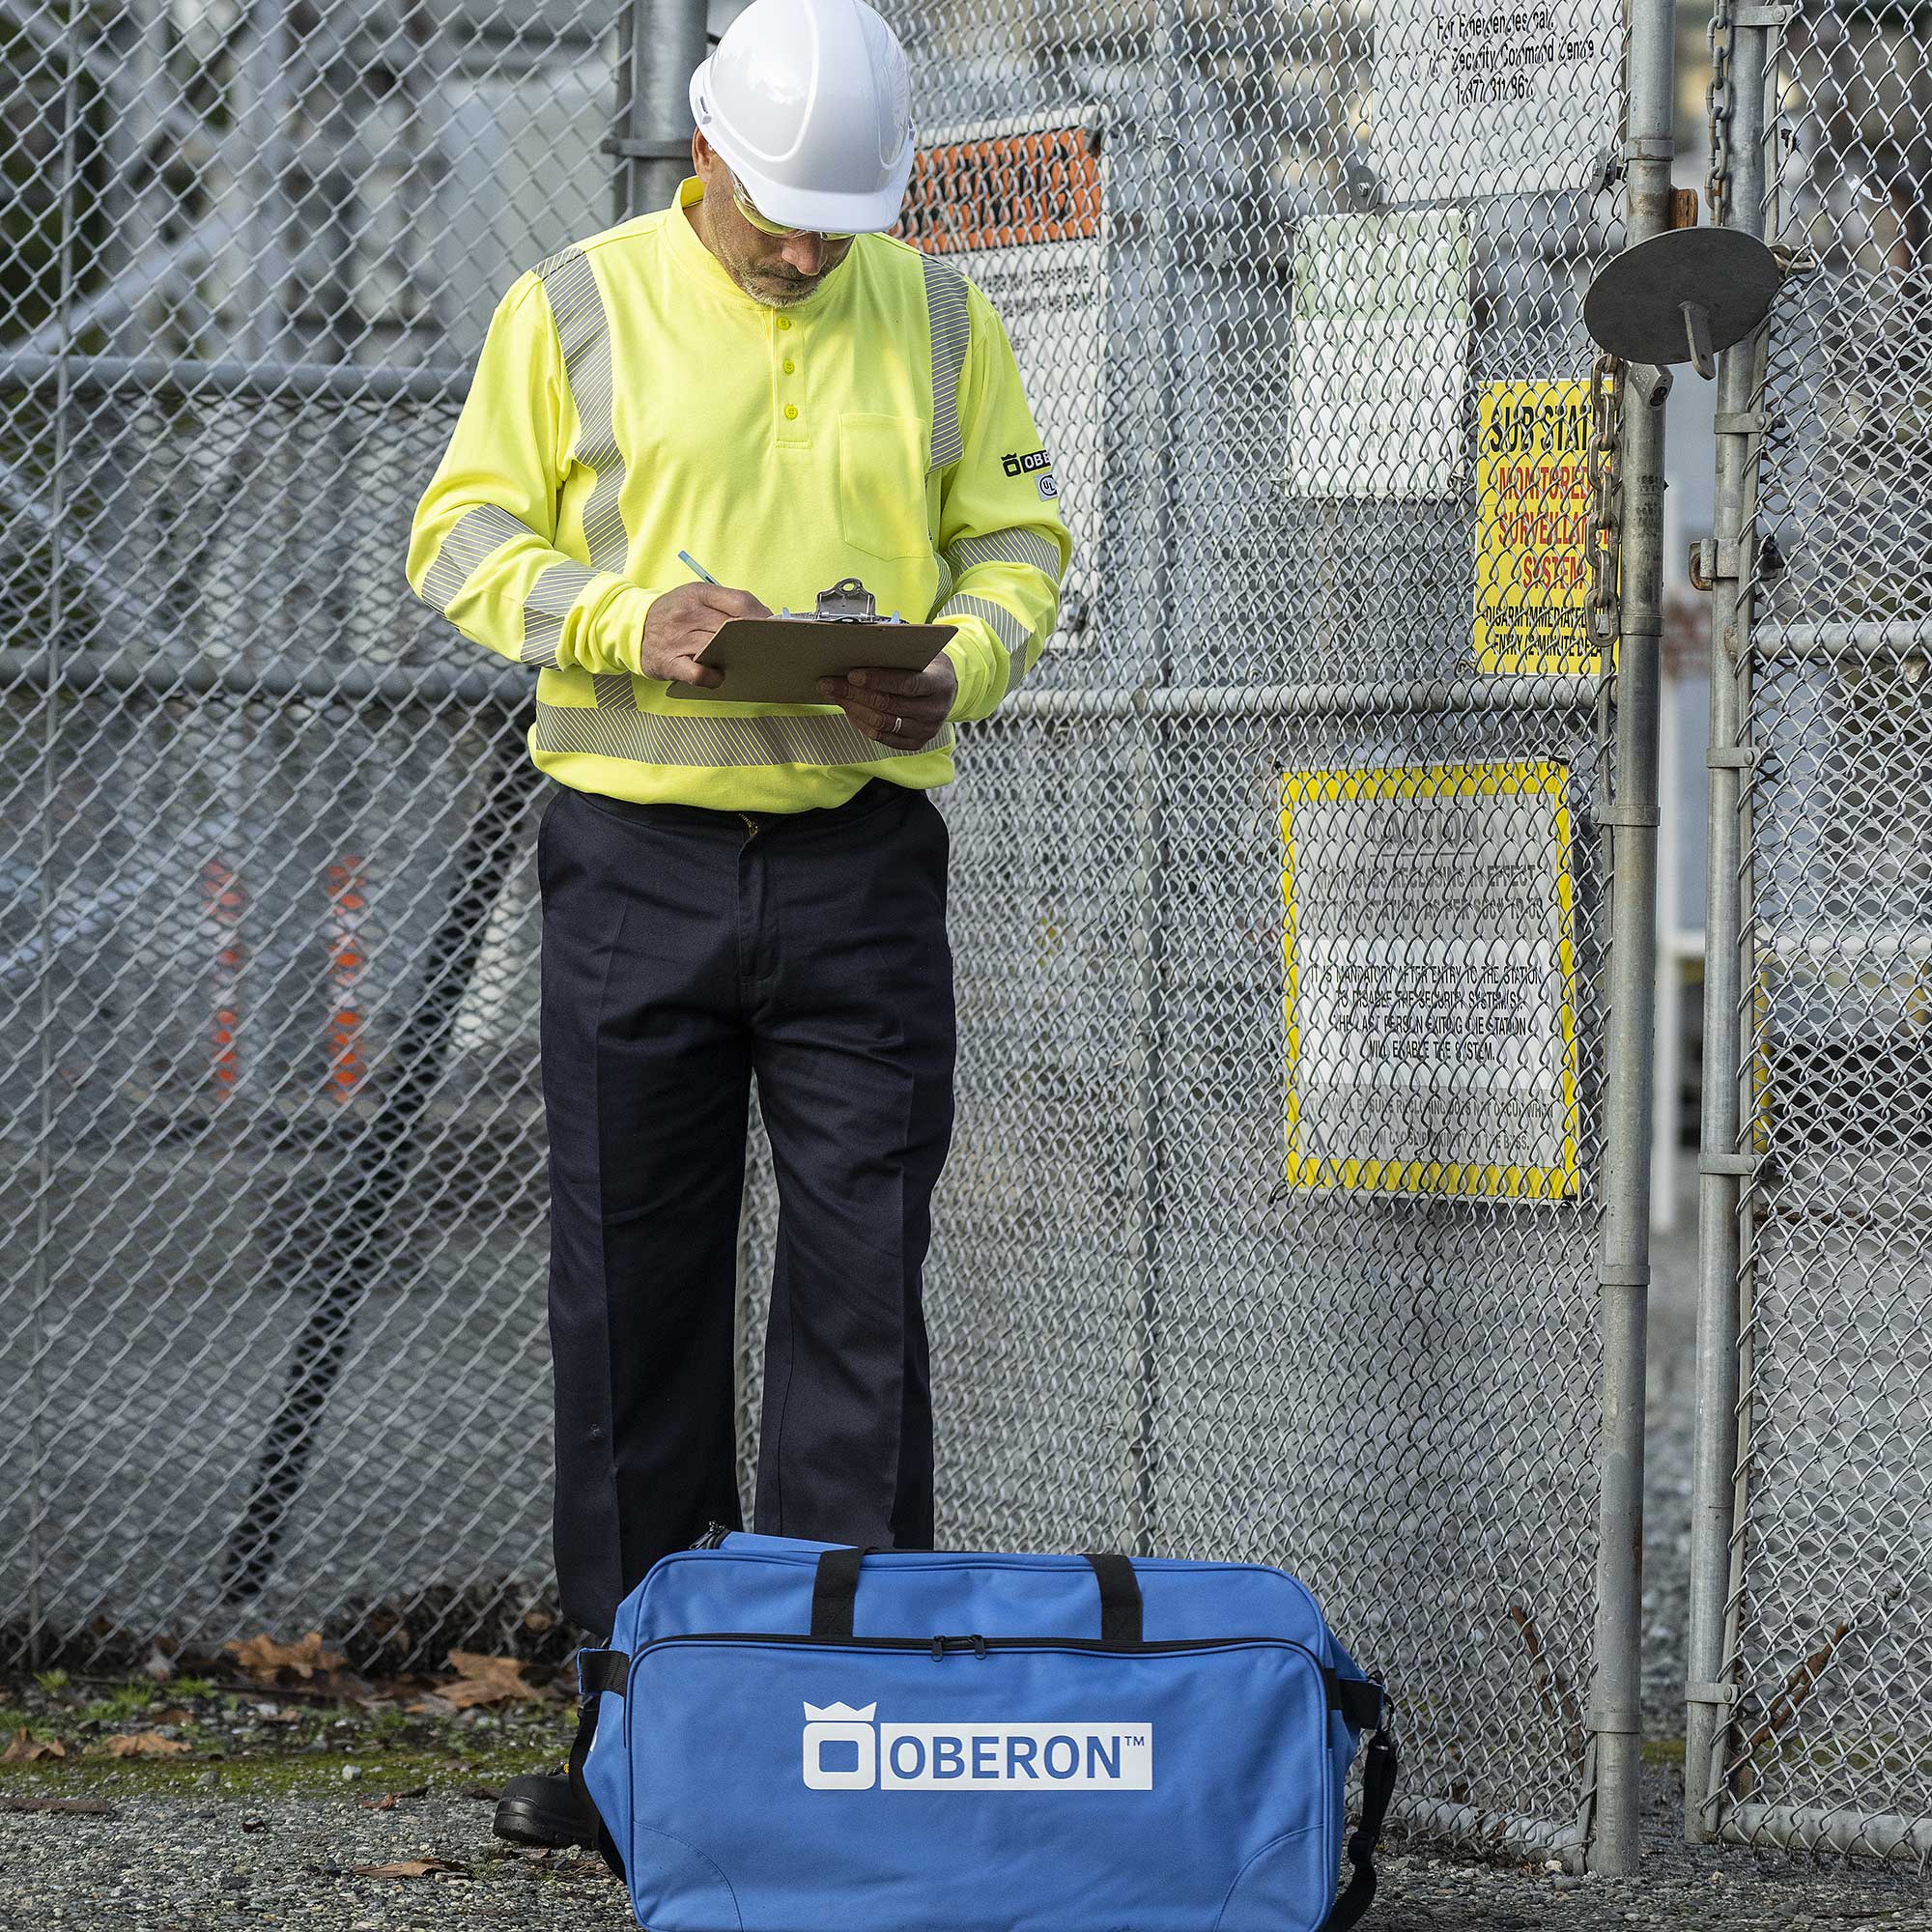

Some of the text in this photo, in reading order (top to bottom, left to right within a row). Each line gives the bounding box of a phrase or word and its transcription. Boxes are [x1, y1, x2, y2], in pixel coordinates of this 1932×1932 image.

[1459, 11, 1526, 38] Emerencies
[1559, 36, 1595, 61] Cene
[1491, 405, 1534, 452] SUB
[1498, 466, 1591, 500] MONITORED
[1497, 511, 1609, 545] SURVEILLANE
[1522, 555, 1583, 590] SYSTEM
[1485, 605, 1523, 627] DISARM
[1525, 605, 1586, 629] IMMEDIATEL
[1493, 634, 1523, 656] ENTRY
[1537, 634, 1576, 657] MINUTE
[1371, 808, 1480, 850] CAUTION
[1487, 864, 1536, 888] EFFECT
[1432, 965, 1462, 983] ENTRY
[1481, 965, 1499, 984] THE
[1503, 965, 1542, 985] STATION
[1352, 990, 1392, 1009] DISABLE
[1332, 1014, 1350, 1033] HE
[1356, 1014, 1380, 1034] AST
[1455, 1041, 1495, 1061] SSTEM.
[1356, 1097, 1394, 1114] ESUE
[1396, 1098, 1445, 1115] RCLOING
[1473, 1100, 1492, 1118] NT
[1493, 1101, 1524, 1119] OCU
[1527, 1101, 1553, 1119] WHN
[1390, 1129, 1420, 1147] COSE
[1422, 1131, 1467, 1148] PXITY
[1483, 1133, 1500, 1150] TE
[1503, 1133, 1530, 1151] BSS.
[889, 1734, 1122, 1780] OBERON
